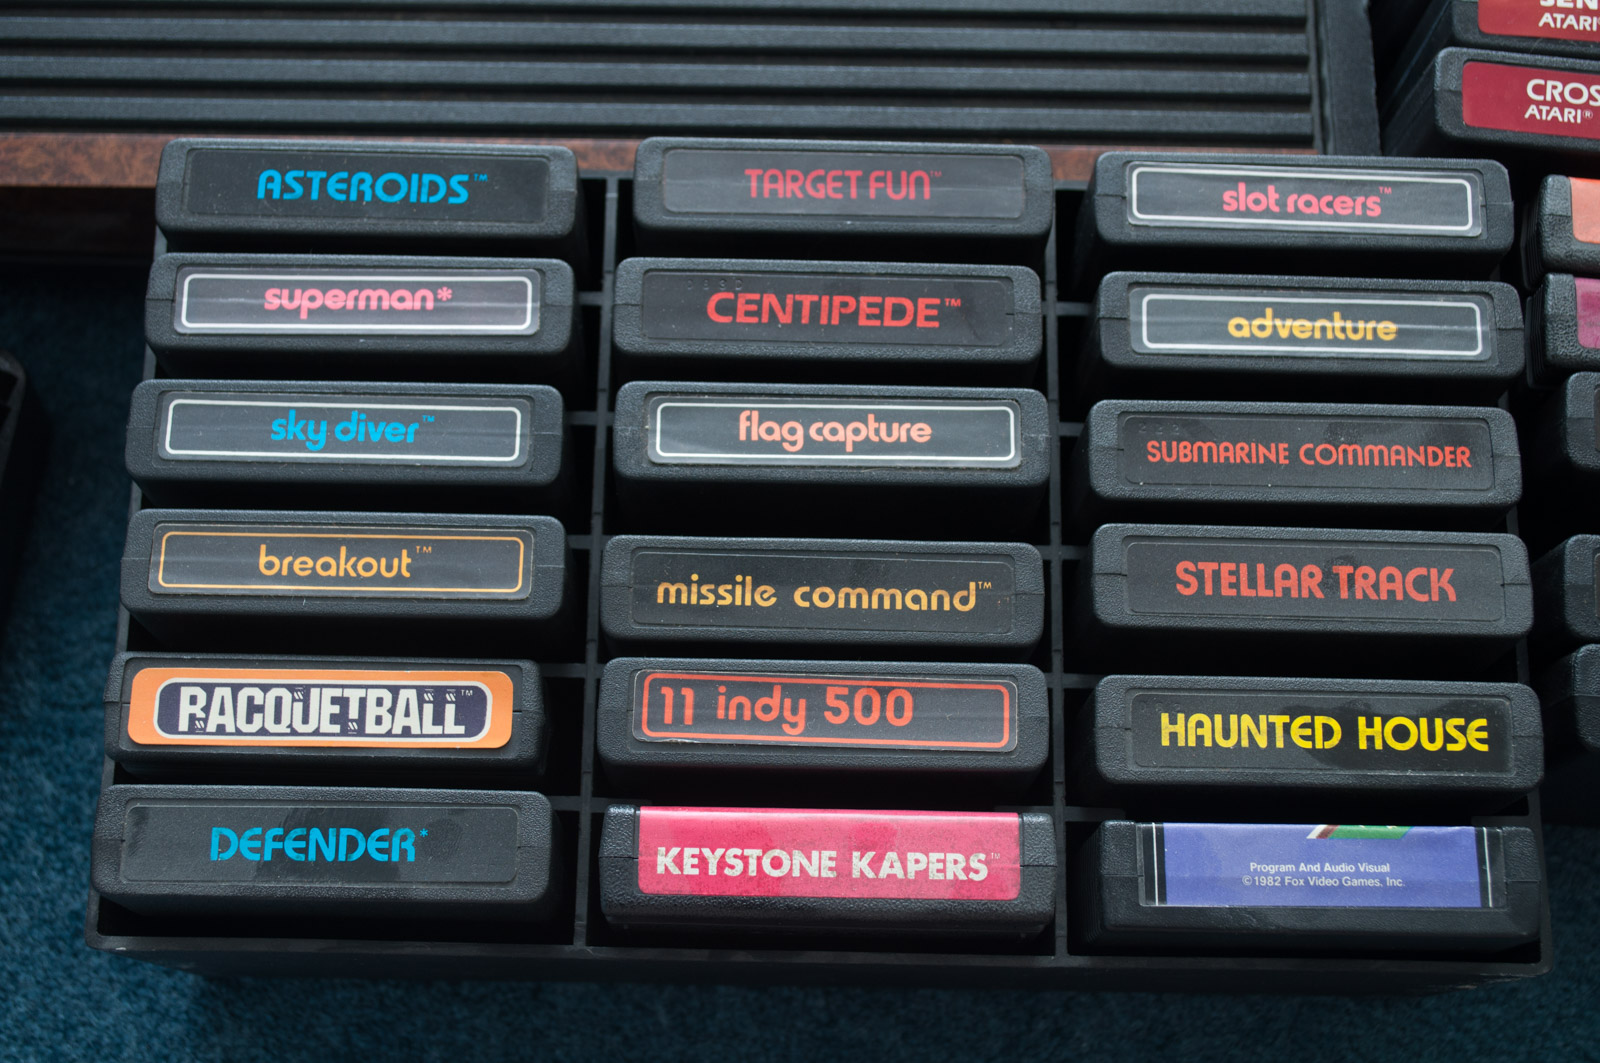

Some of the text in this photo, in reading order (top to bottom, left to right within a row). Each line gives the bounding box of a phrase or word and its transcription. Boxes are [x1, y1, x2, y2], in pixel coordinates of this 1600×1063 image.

[746, 168, 864, 200] TARGET
[1222, 182, 1281, 213] slot
[1228, 308, 1399, 341] adventure
[271, 410, 327, 452] sky
[738, 410, 932, 453] flag capture
[1147, 441, 1472, 467] SUBMARINE COMMANDER
[657, 574, 777, 607] missile
[1176, 561, 1456, 602] STELLAR TRACK
[716, 685, 807, 735] indy
[824, 687, 914, 727] 500
[1161, 713, 1489, 751] HAUNTED HOUSE
[657, 847, 837, 878] KEYSTONE
[1250, 862, 1391, 874] Program And Audio Visual
[1284, 876, 1305, 887] Fox
[1308, 876, 1339, 887] Video
[1341, 876, 1383, 888] Games,
[1386, 877, 1406, 887] Inc.
